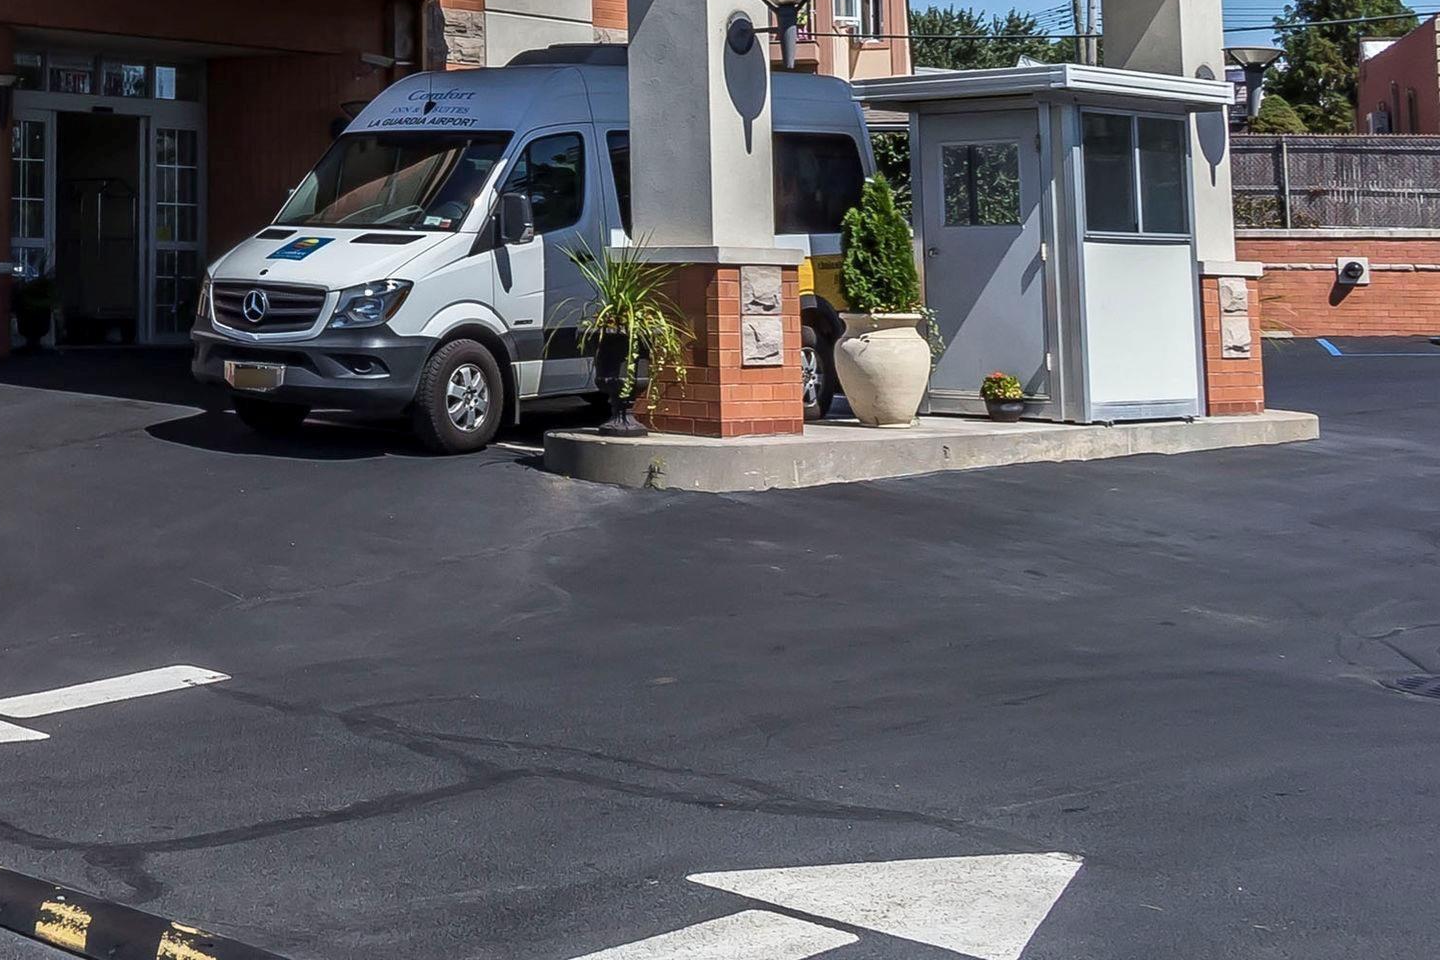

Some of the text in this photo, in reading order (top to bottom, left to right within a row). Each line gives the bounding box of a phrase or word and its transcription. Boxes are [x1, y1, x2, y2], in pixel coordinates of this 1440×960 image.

[408, 88, 476, 101] Comfort
[367, 116, 479, 128] LA GUARDIA AIRPORT
